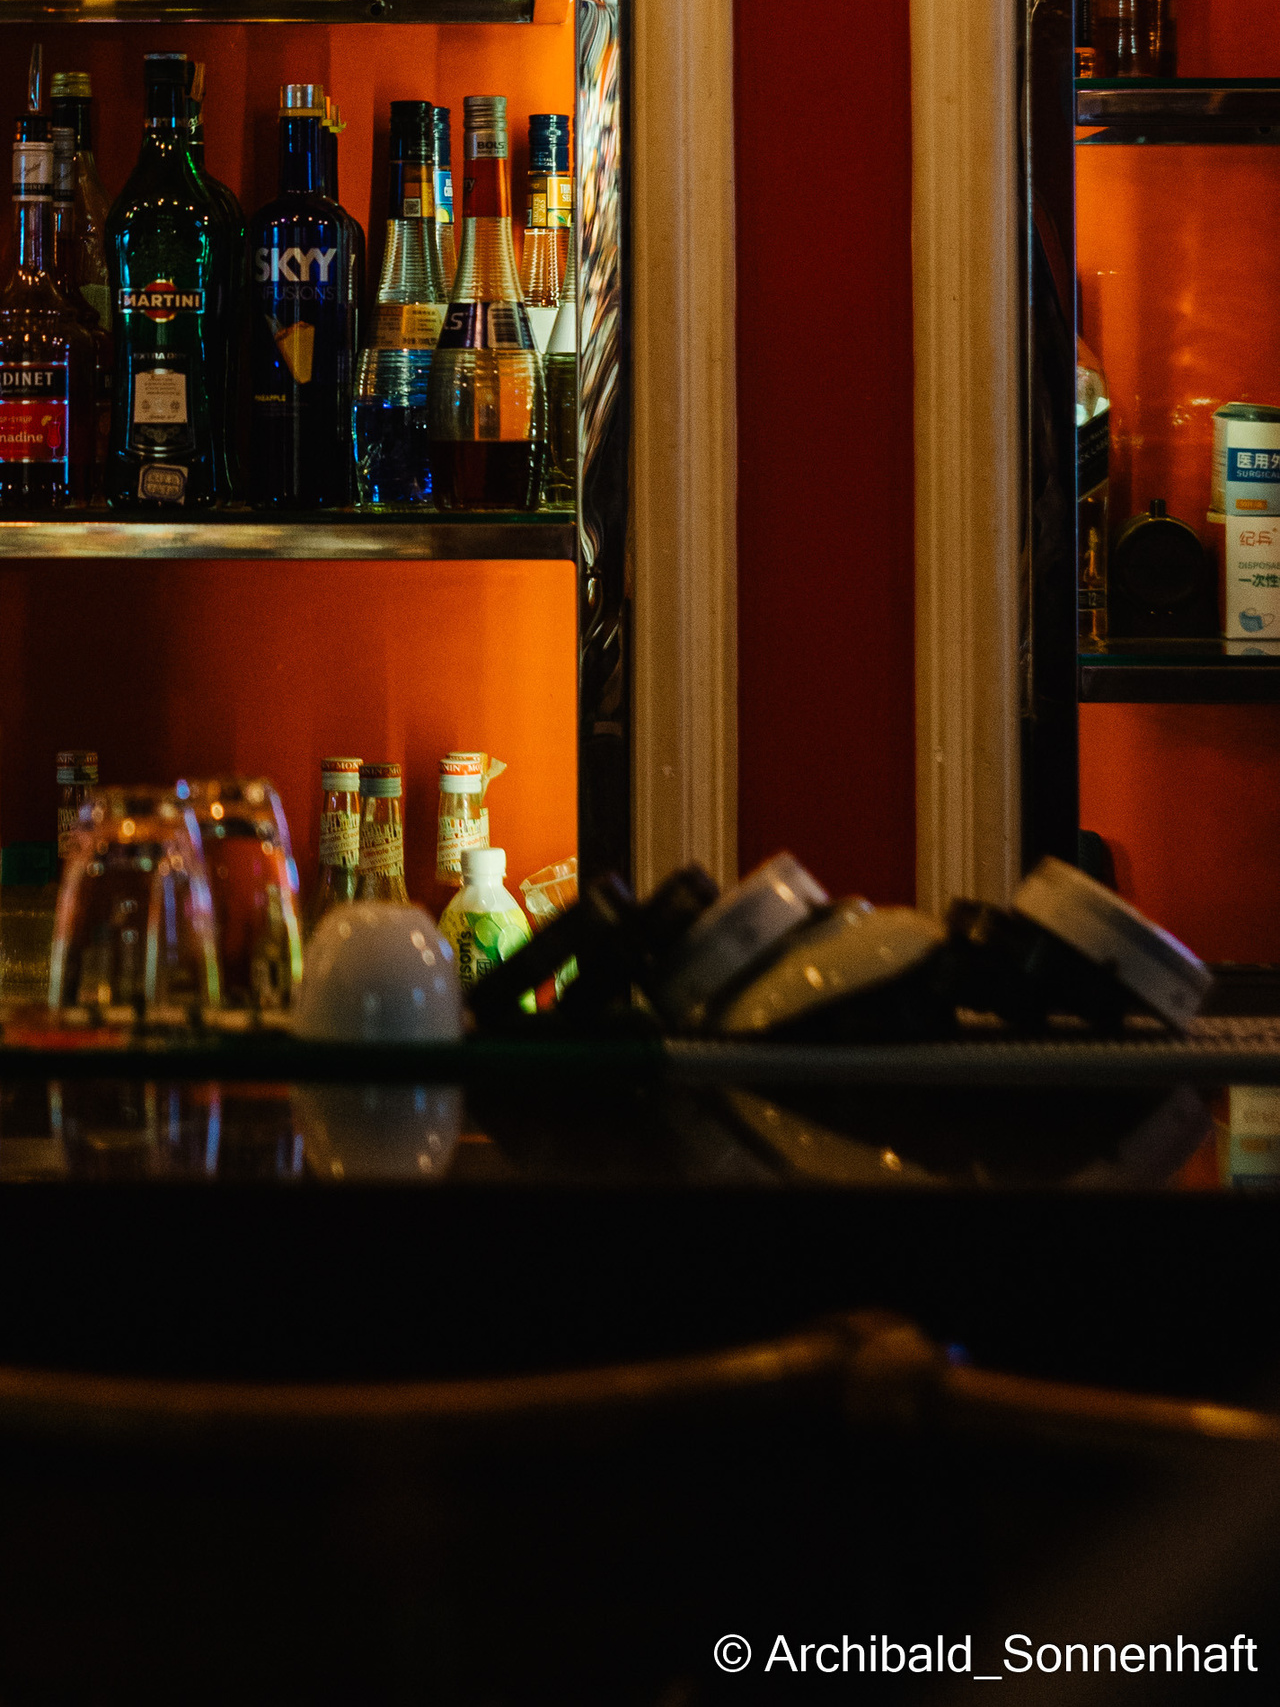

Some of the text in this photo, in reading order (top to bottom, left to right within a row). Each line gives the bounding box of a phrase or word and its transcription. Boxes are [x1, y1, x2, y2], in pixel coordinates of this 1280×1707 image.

[477, 141, 506, 150] BOLS
[255, 247, 337, 282] SKYY
[124, 295, 200, 308] MARTINI
